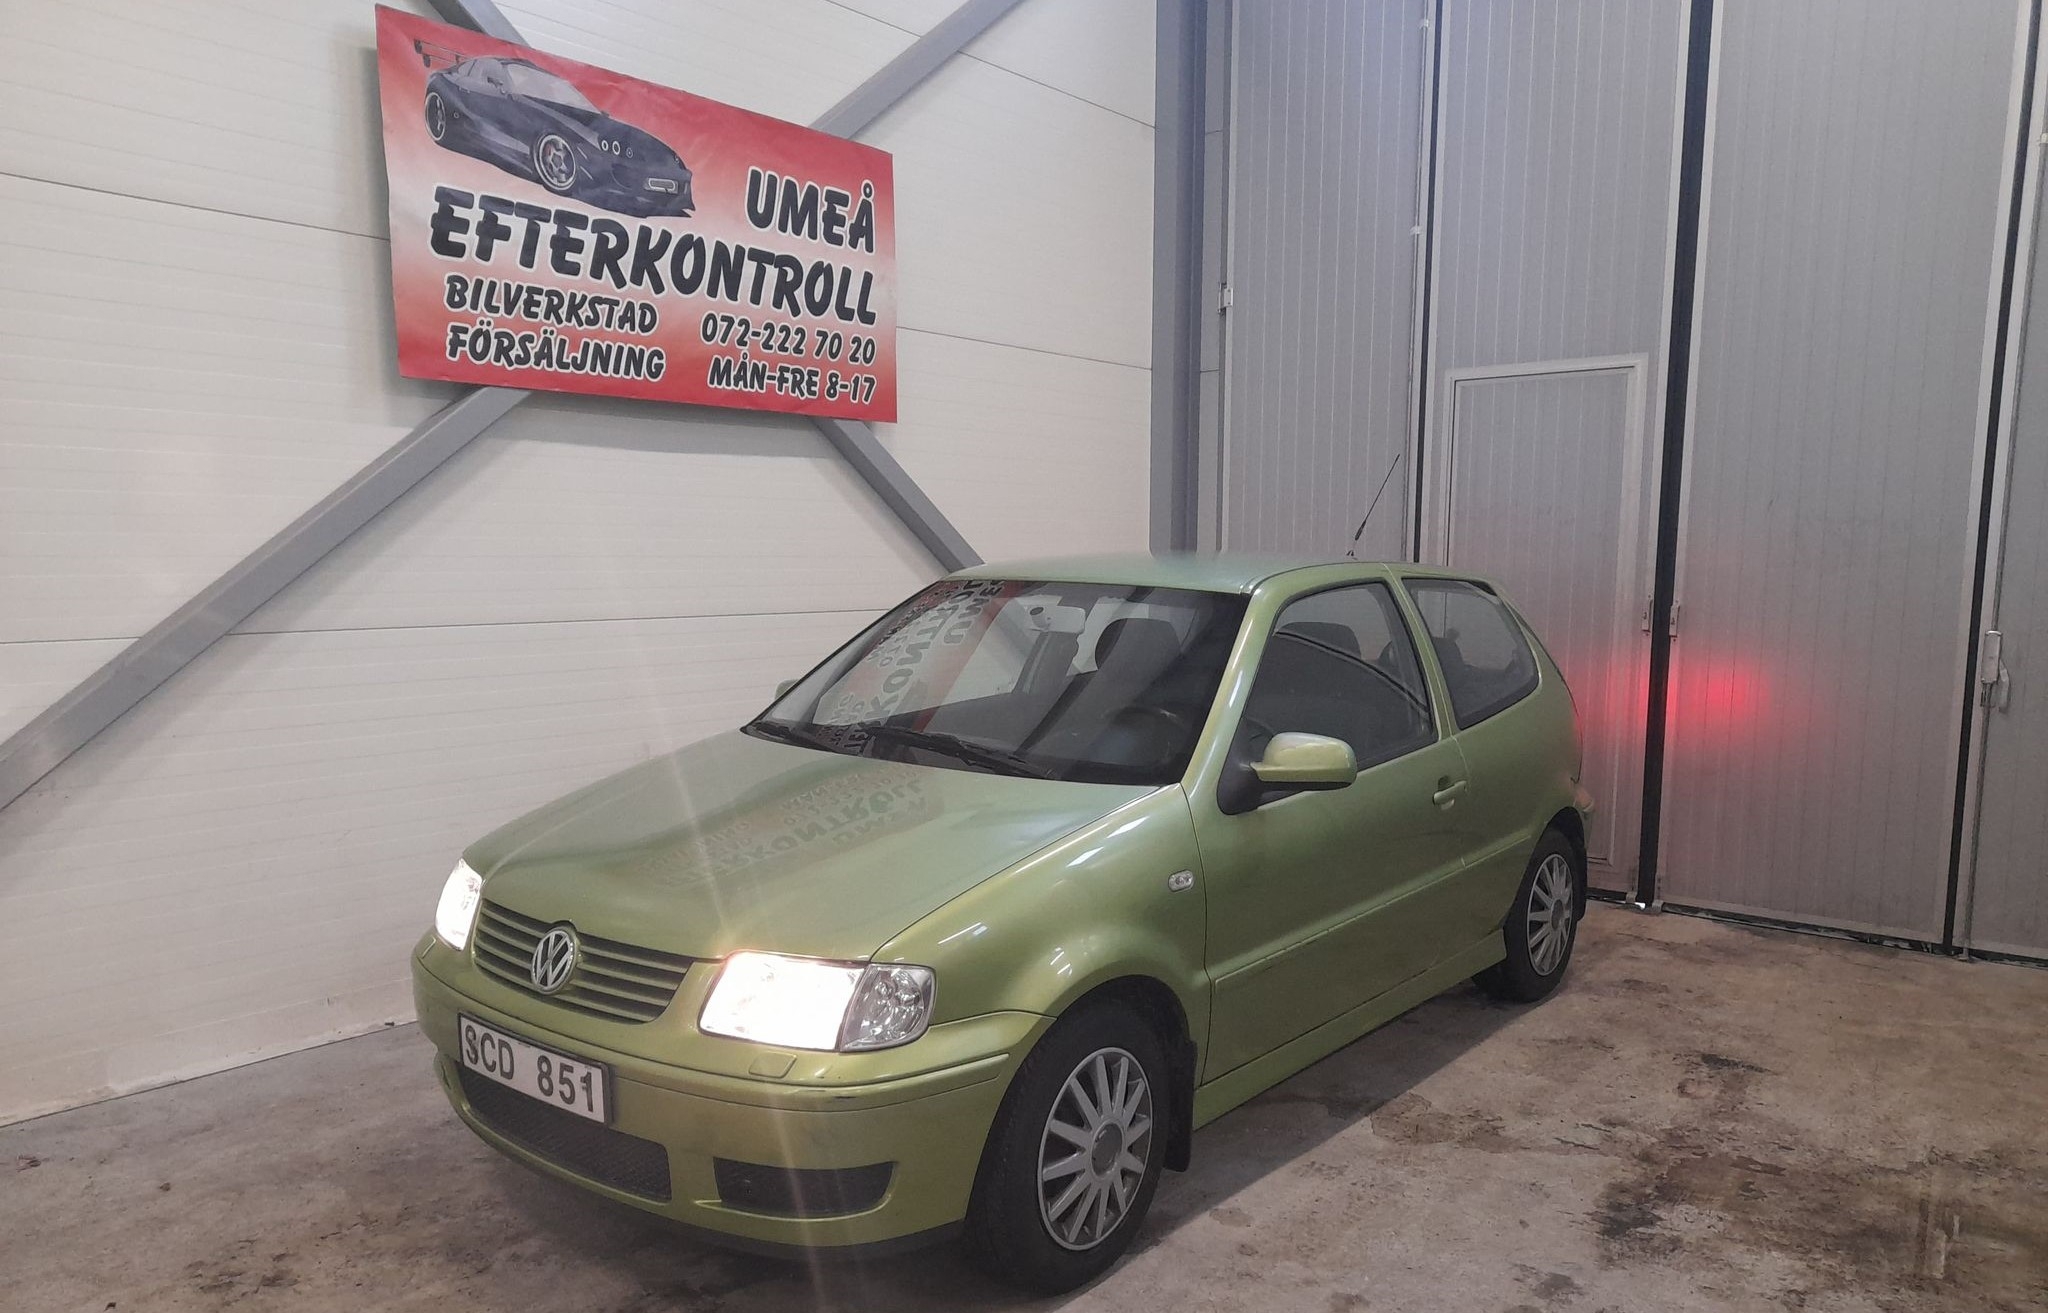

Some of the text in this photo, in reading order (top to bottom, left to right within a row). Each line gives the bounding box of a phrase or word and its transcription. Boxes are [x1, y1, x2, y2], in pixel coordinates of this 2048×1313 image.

[746, 168, 874, 253] UMEÅ
[430, 186, 877, 326] EFTERKONTROLL
[446, 274, 658, 334] BILVERKSTAD
[448, 319, 665, 380] FÖRSÄLJNING
[701, 312, 876, 365] 072-222 70 20
[708, 353, 876, 403] MÅN-FRE 8-17
[465, 1024, 594, 1114] SCD 851
